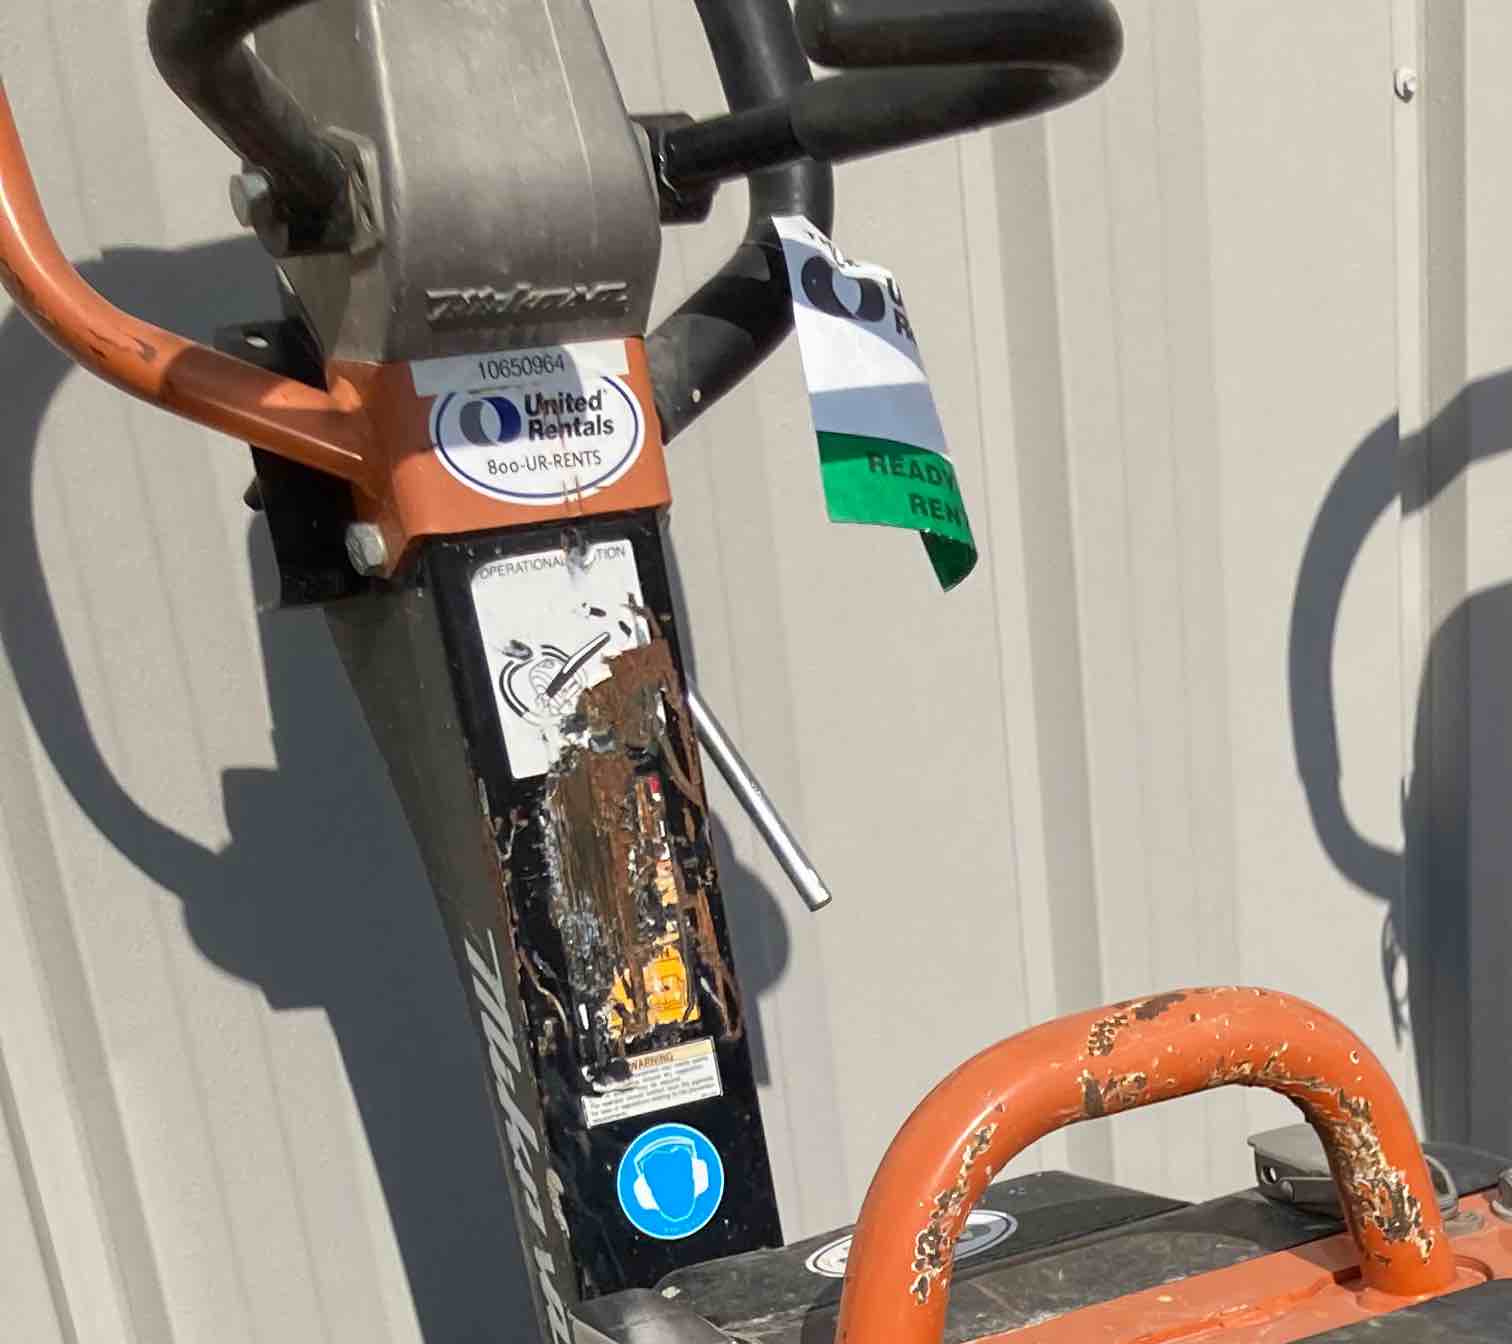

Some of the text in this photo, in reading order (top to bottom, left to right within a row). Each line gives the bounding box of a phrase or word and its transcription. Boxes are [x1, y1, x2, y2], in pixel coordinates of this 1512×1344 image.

[478, 353, 566, 380] 10650964
[524, 389, 603, 417] United
[528, 415, 615, 441] Rentals
[487, 449, 602, 476] 800-UR-RENTS
